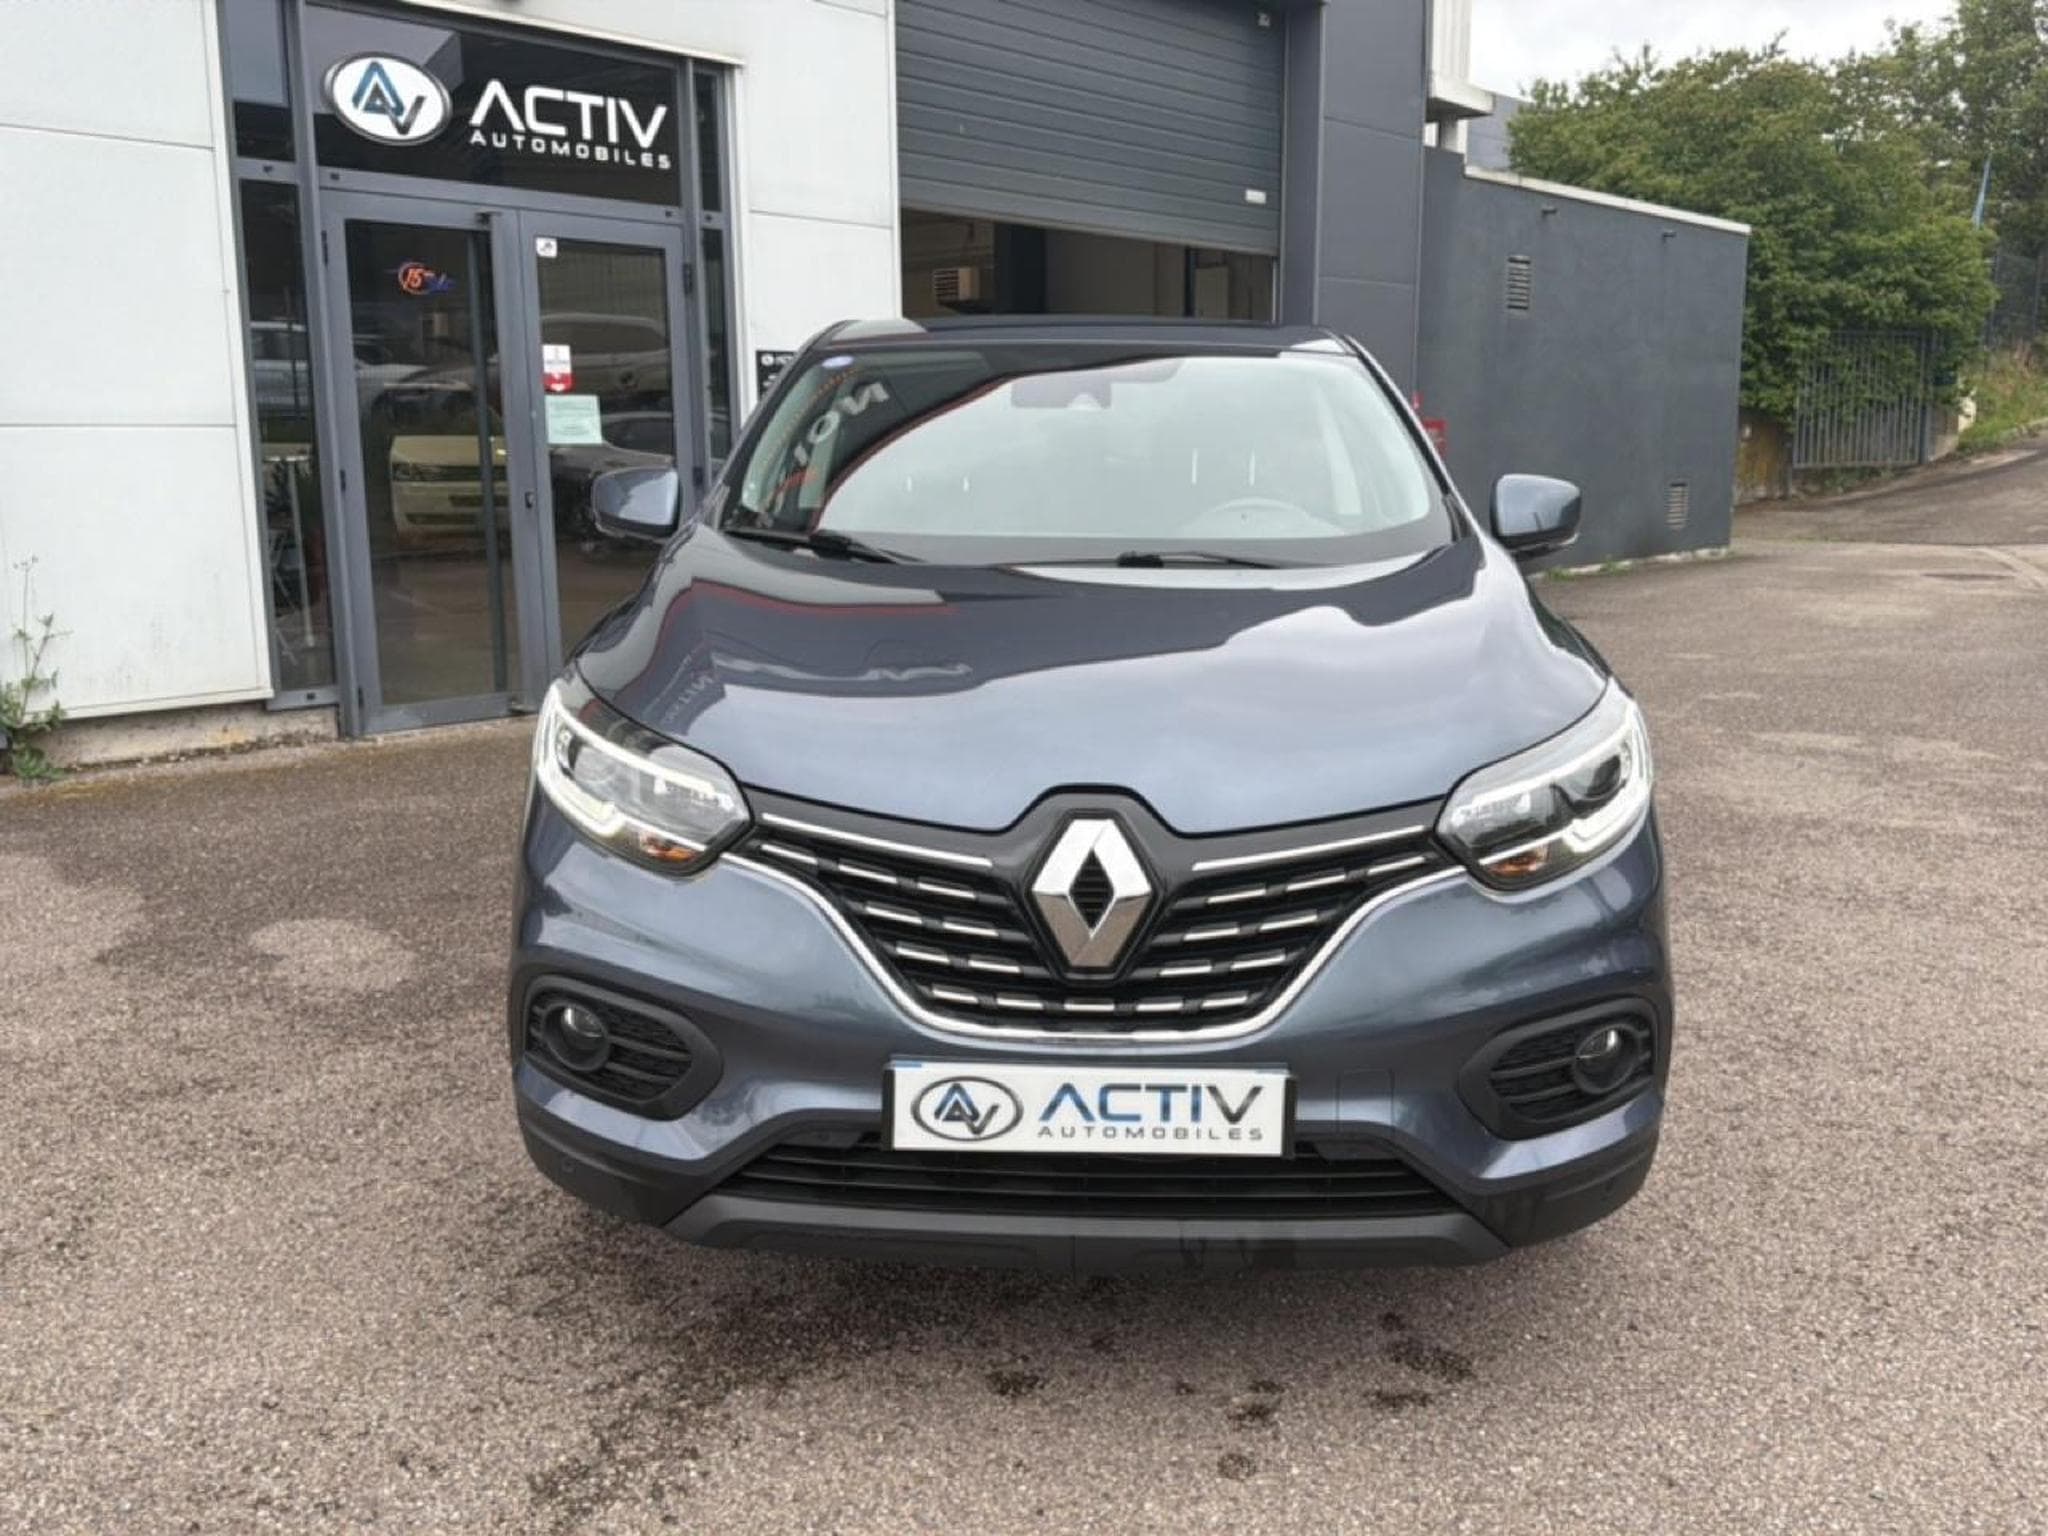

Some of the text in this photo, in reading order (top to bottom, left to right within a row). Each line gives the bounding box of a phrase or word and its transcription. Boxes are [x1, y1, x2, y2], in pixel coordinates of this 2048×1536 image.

[469, 78, 667, 148] ACTIV
[469, 130, 672, 170] AUTOMOBILES
[1038, 1082, 1264, 1125] ACTIV
[1037, 1126, 1264, 1142] AUTOMOBILES
